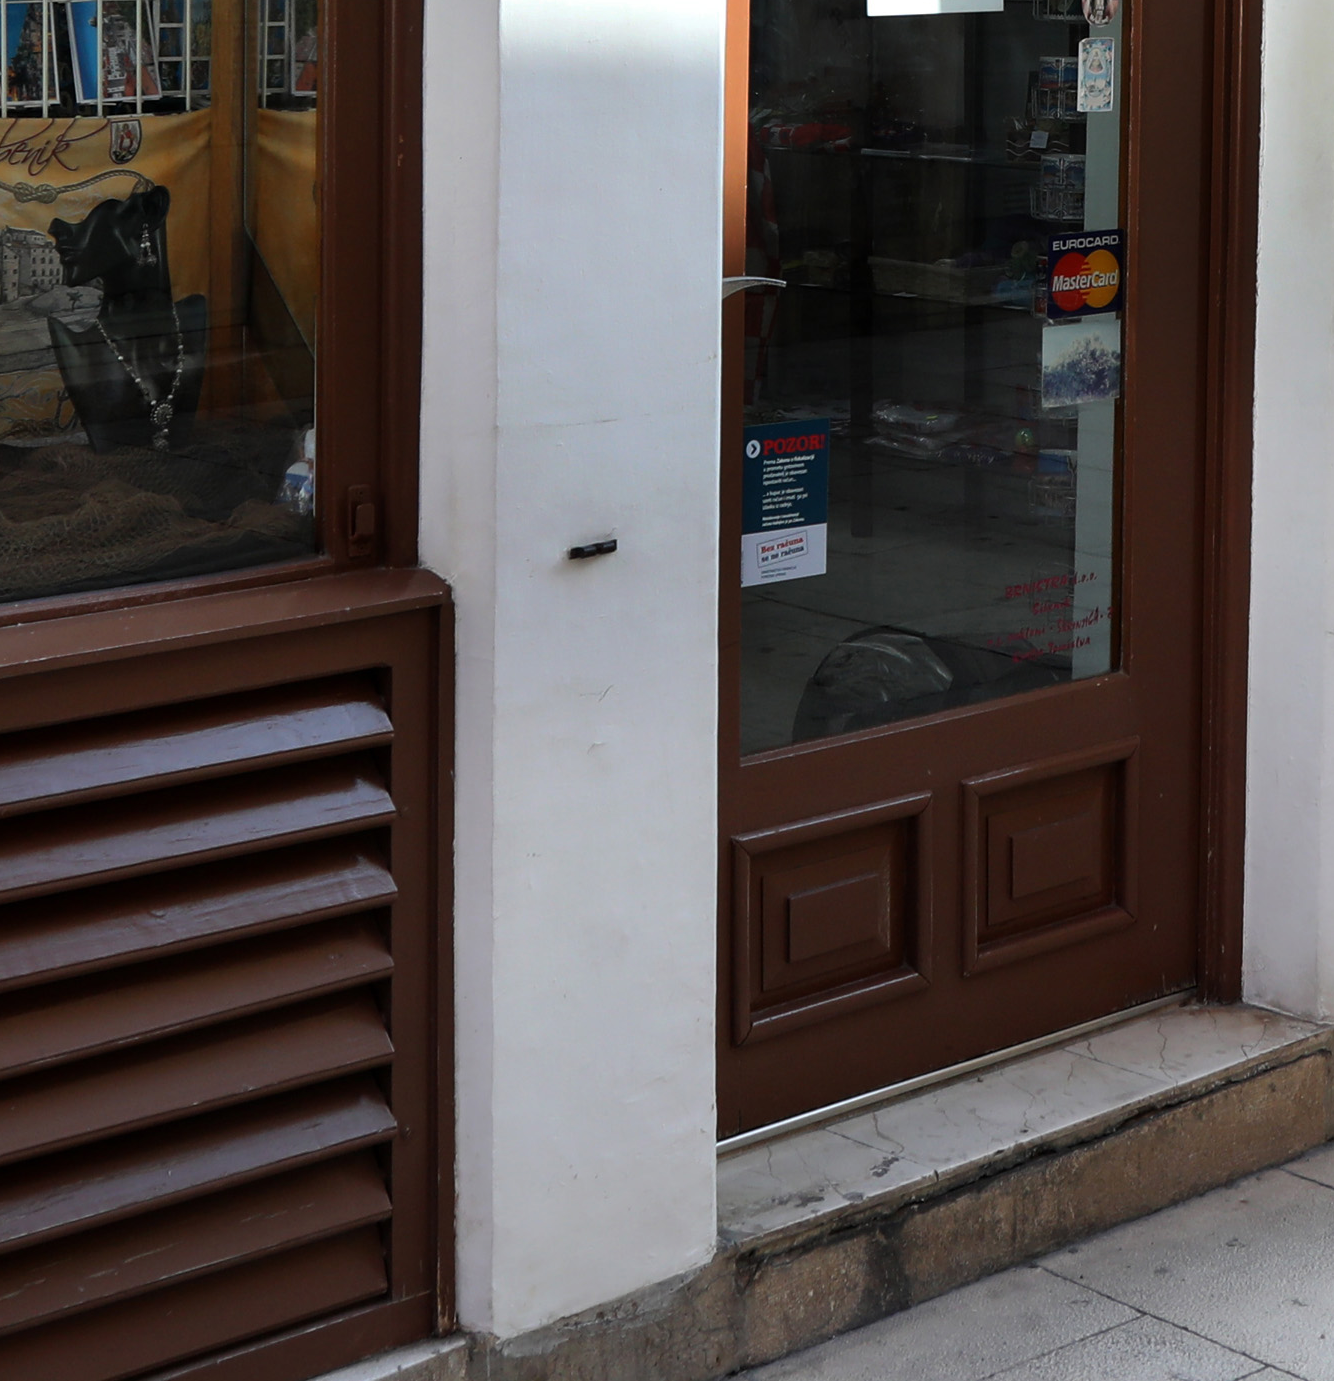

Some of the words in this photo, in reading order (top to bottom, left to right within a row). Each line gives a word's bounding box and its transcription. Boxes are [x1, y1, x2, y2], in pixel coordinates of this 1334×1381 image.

[1052, 234, 1120, 252] EUROCARD
[1052, 269, 1118, 292] MasterCard
[762, 433, 826, 456] POZOR!
